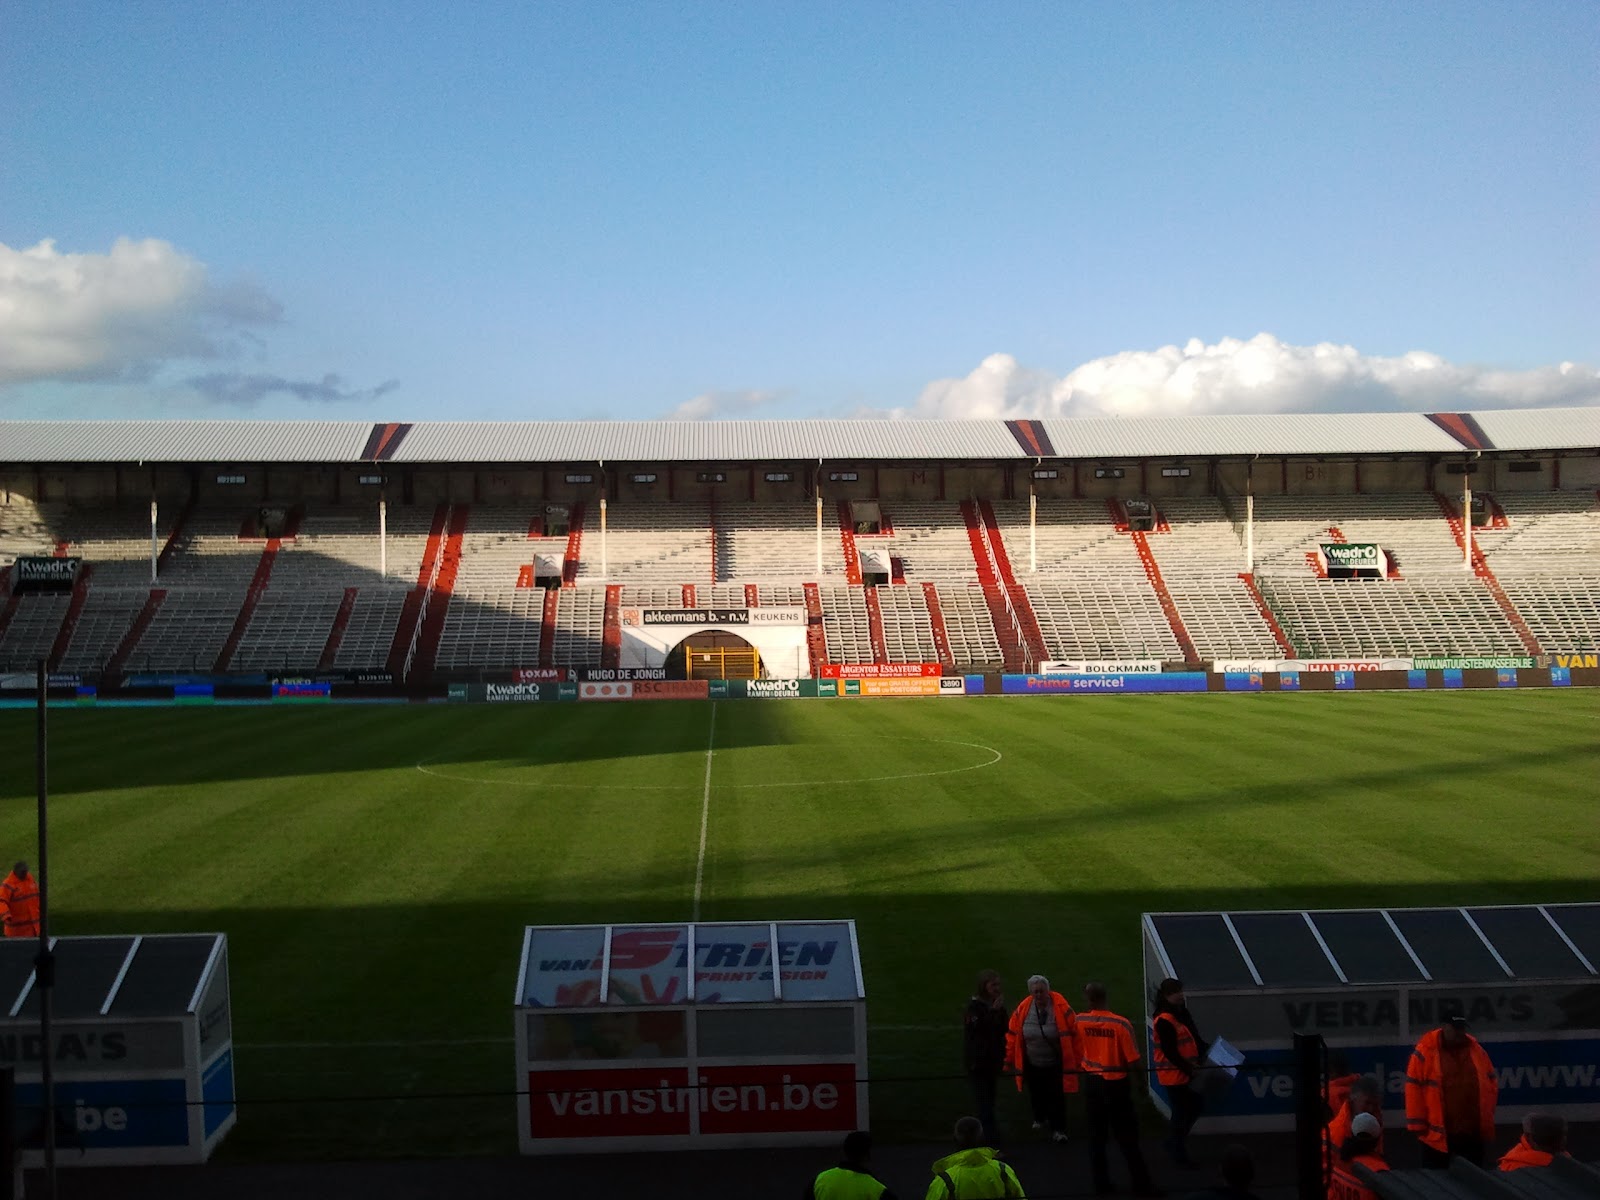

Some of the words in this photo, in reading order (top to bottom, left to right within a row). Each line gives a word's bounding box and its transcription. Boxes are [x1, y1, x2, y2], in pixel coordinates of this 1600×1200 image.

[1322, 546, 1377, 558] KwadrO
[644, 611, 707, 622] akkermans
[754, 613, 799, 621] KEUKENS
[1556, 655, 1599, 669] VAN
[520, 669, 559, 679] LOXAM
[588, 669, 616, 681] HUGO
[618, 669, 632, 681] DE
[633, 668, 666, 680] JONGH
[839, 664, 879, 674] ARGENTOR
[880, 664, 922, 673] ESSAYEURS
[1085, 664, 1157, 673] BOLCKMANS
[746, 679, 799, 691] KwadrO
[942, 680, 961, 688] 3890
[1027, 675, 1071, 688] Prima
[1073, 675, 1125, 688] service!
[486, 683, 540, 695] KwadrO
[635, 682, 663, 694] RSC
[540, 958, 593, 972] VAN
[780, 969, 828, 981] SIGN
[548, 1073, 840, 1117] vanstrien.be
